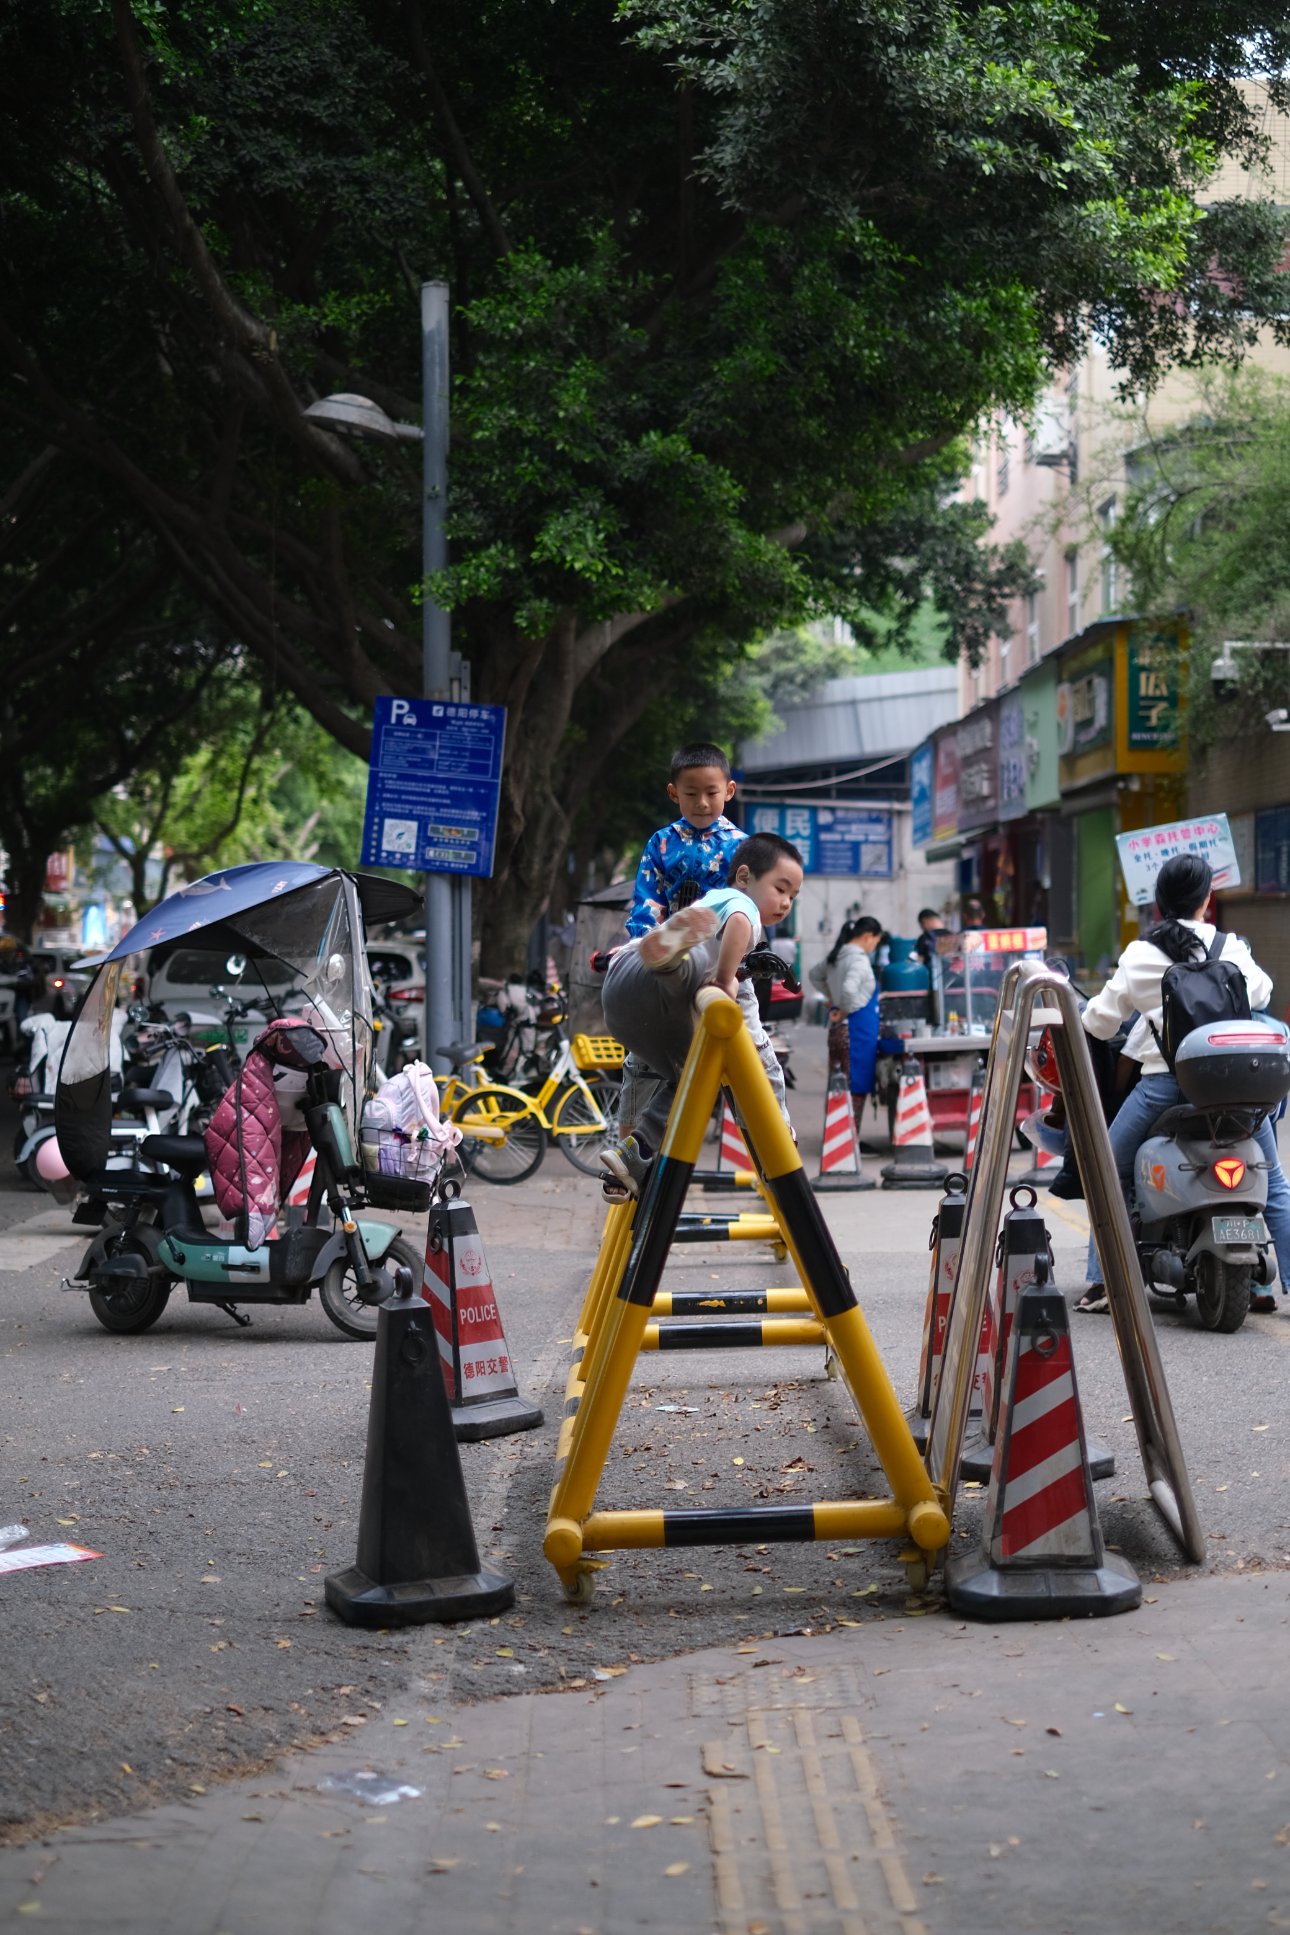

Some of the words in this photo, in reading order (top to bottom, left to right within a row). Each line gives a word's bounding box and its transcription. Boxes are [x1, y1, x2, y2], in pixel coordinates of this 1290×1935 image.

[391, 700, 409, 724] P
[460, 1304, 497, 1325] POLICE
[463, 1355, 509, 1380] 德阳交警
